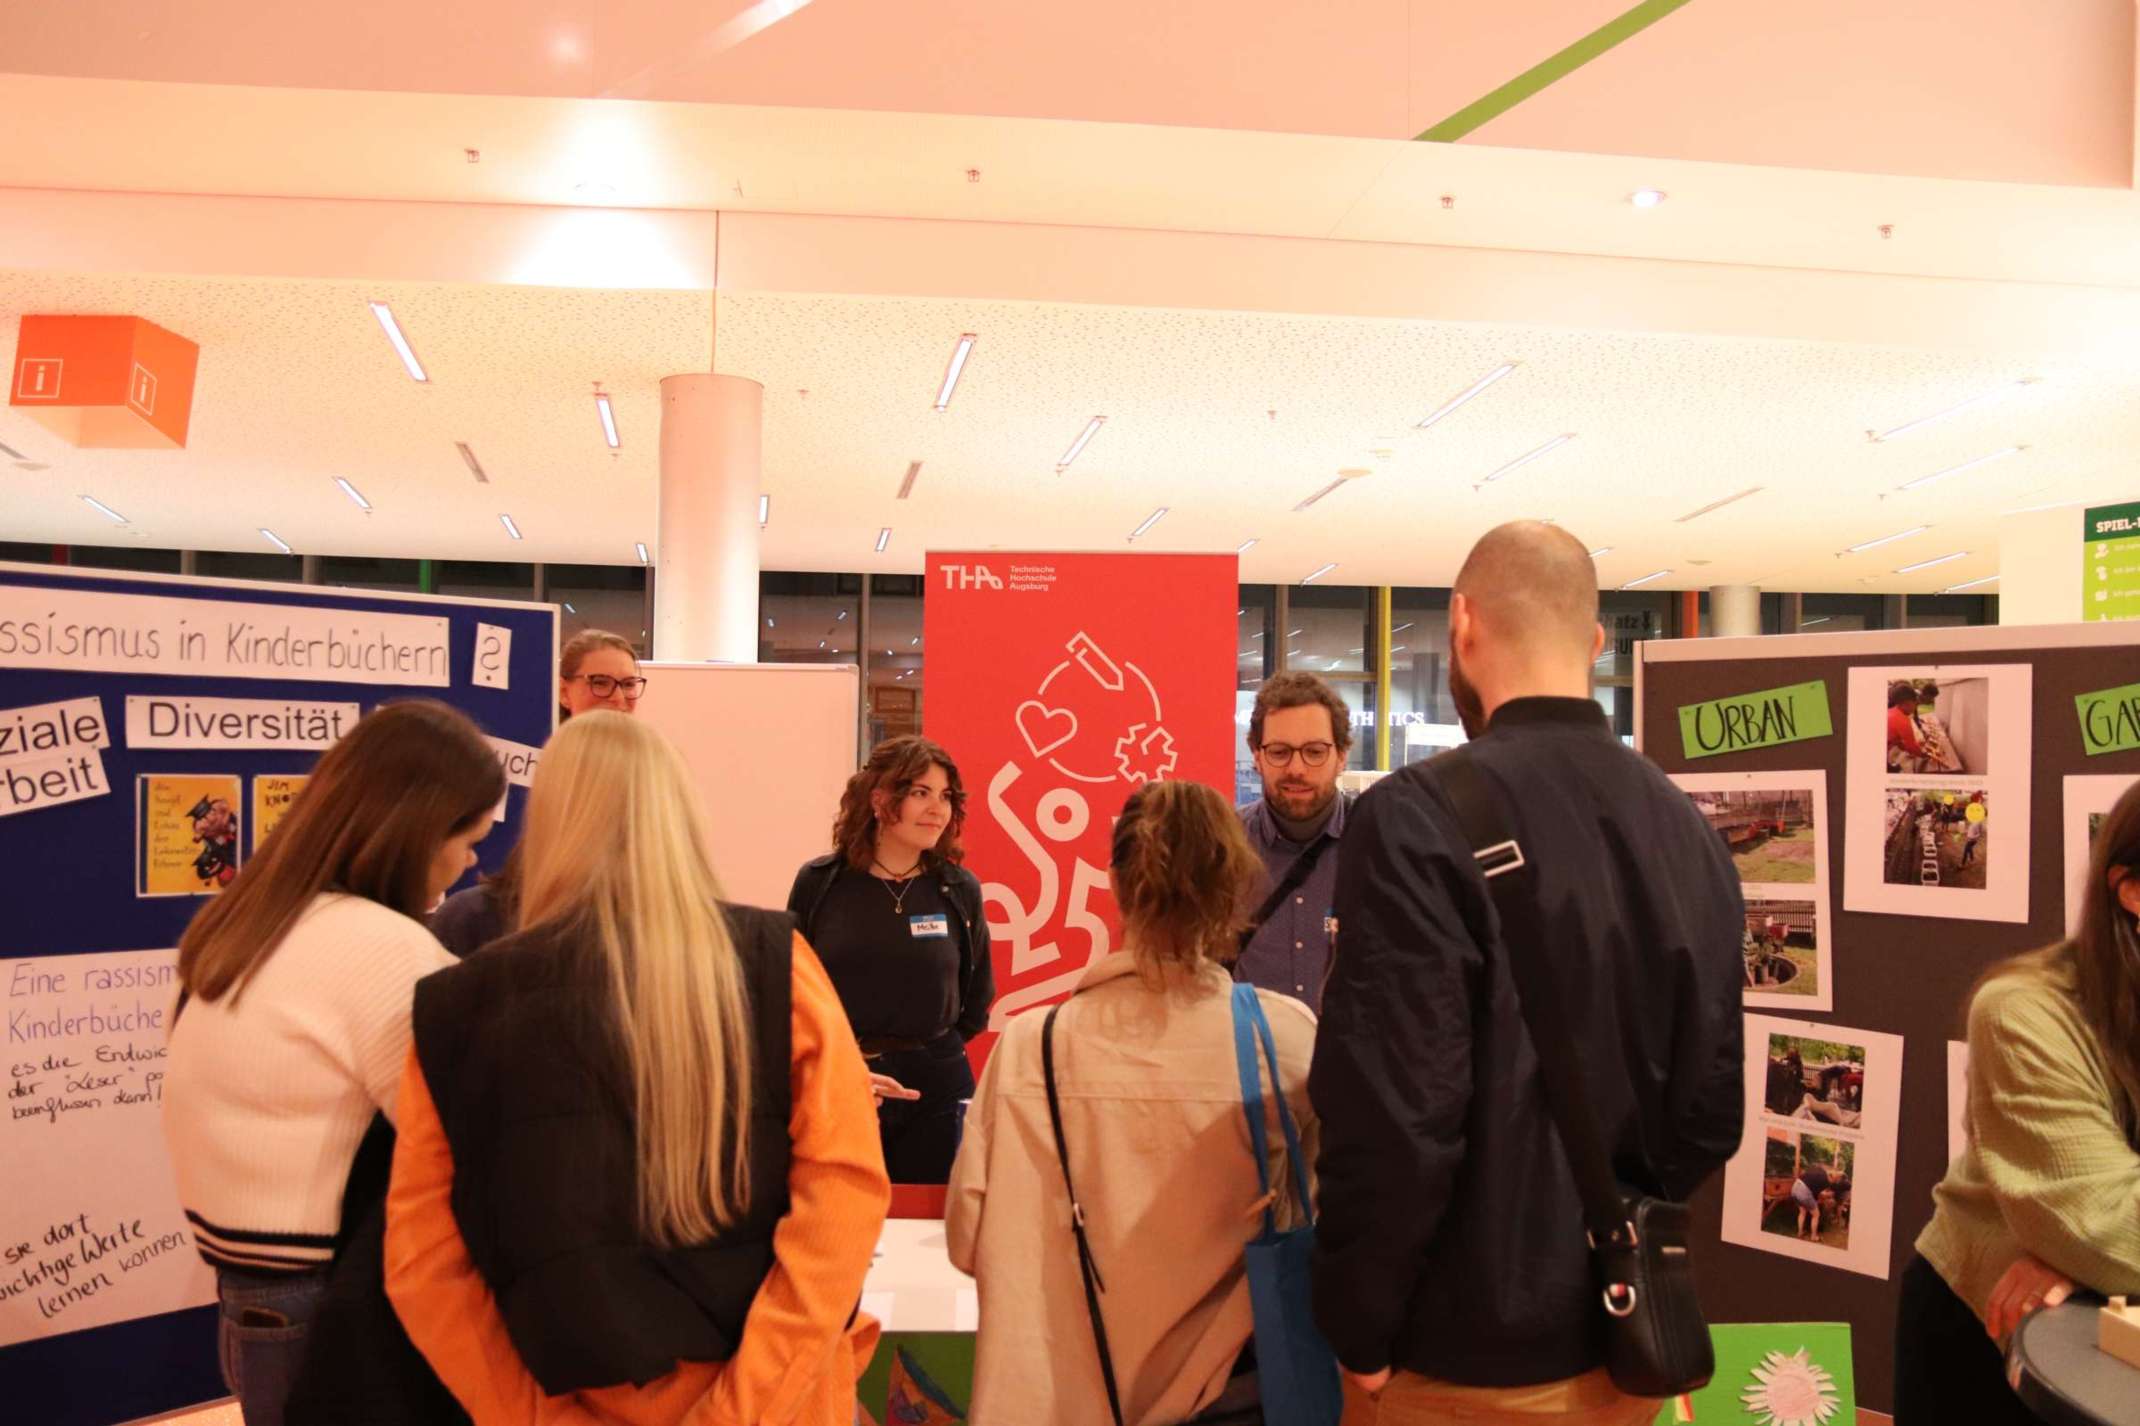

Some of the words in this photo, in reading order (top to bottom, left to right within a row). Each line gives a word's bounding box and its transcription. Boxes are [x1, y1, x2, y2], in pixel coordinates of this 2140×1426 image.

[940, 565, 1004, 590] THA
[1009, 582, 1048, 592] Augsburg
[1010, 565, 1055, 573] Technische
[1010, 574, 1057, 582] Hochschule
[0, 612, 160, 659] ssismus
[179, 620, 206, 661] in
[226, 622, 449, 677] Kinderbüchern
[0, 709, 100, 756] ziale
[149, 702, 344, 741] Diversität
[1695, 696, 1797, 751] URBAN
[0, 757, 98, 804] beit
[9, 962, 66, 997] Eine
[9, 1000, 162, 1043] Kinderbüche
[11, 1062, 37, 1078] es
[42, 1055, 82, 1071] die
[8, 1079, 43, 1099] der
[4, 1241, 35, 1265] sie
[44, 1213, 90, 1246] dort
[38, 1273, 113, 1318] lernen
